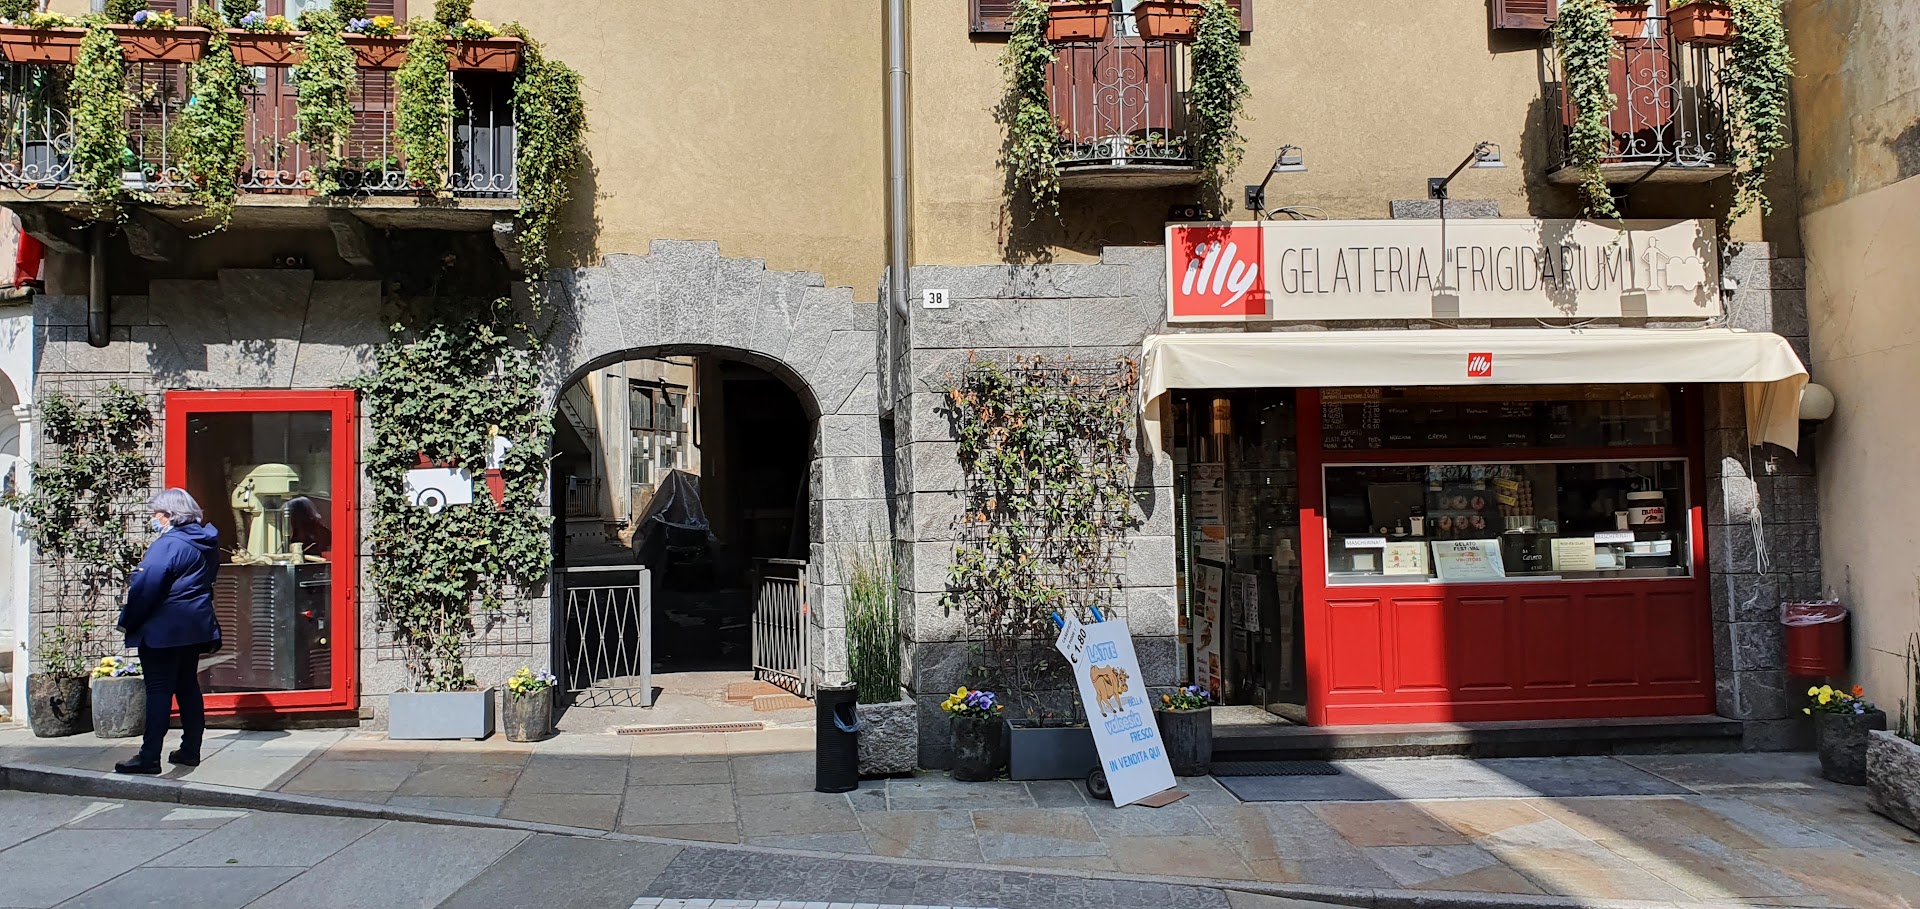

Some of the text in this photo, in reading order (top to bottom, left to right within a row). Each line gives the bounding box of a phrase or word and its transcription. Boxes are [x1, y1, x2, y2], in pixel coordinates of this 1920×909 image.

[1181, 240, 1259, 308] illy
[1280, 244, 1632, 295] GELATERIA "FRIGIDARIUM"
[928, 292, 943, 304] 38
[1468, 355, 1491, 376] illy
[1070, 628, 1087, 664] € 1.80
[1086, 641, 1118, 664] LATTE
[1104, 711, 1143, 736] valsesia
[1129, 726, 1154, 743] FRESCO
[1108, 745, 1161, 772] IN VENDITA QUI
